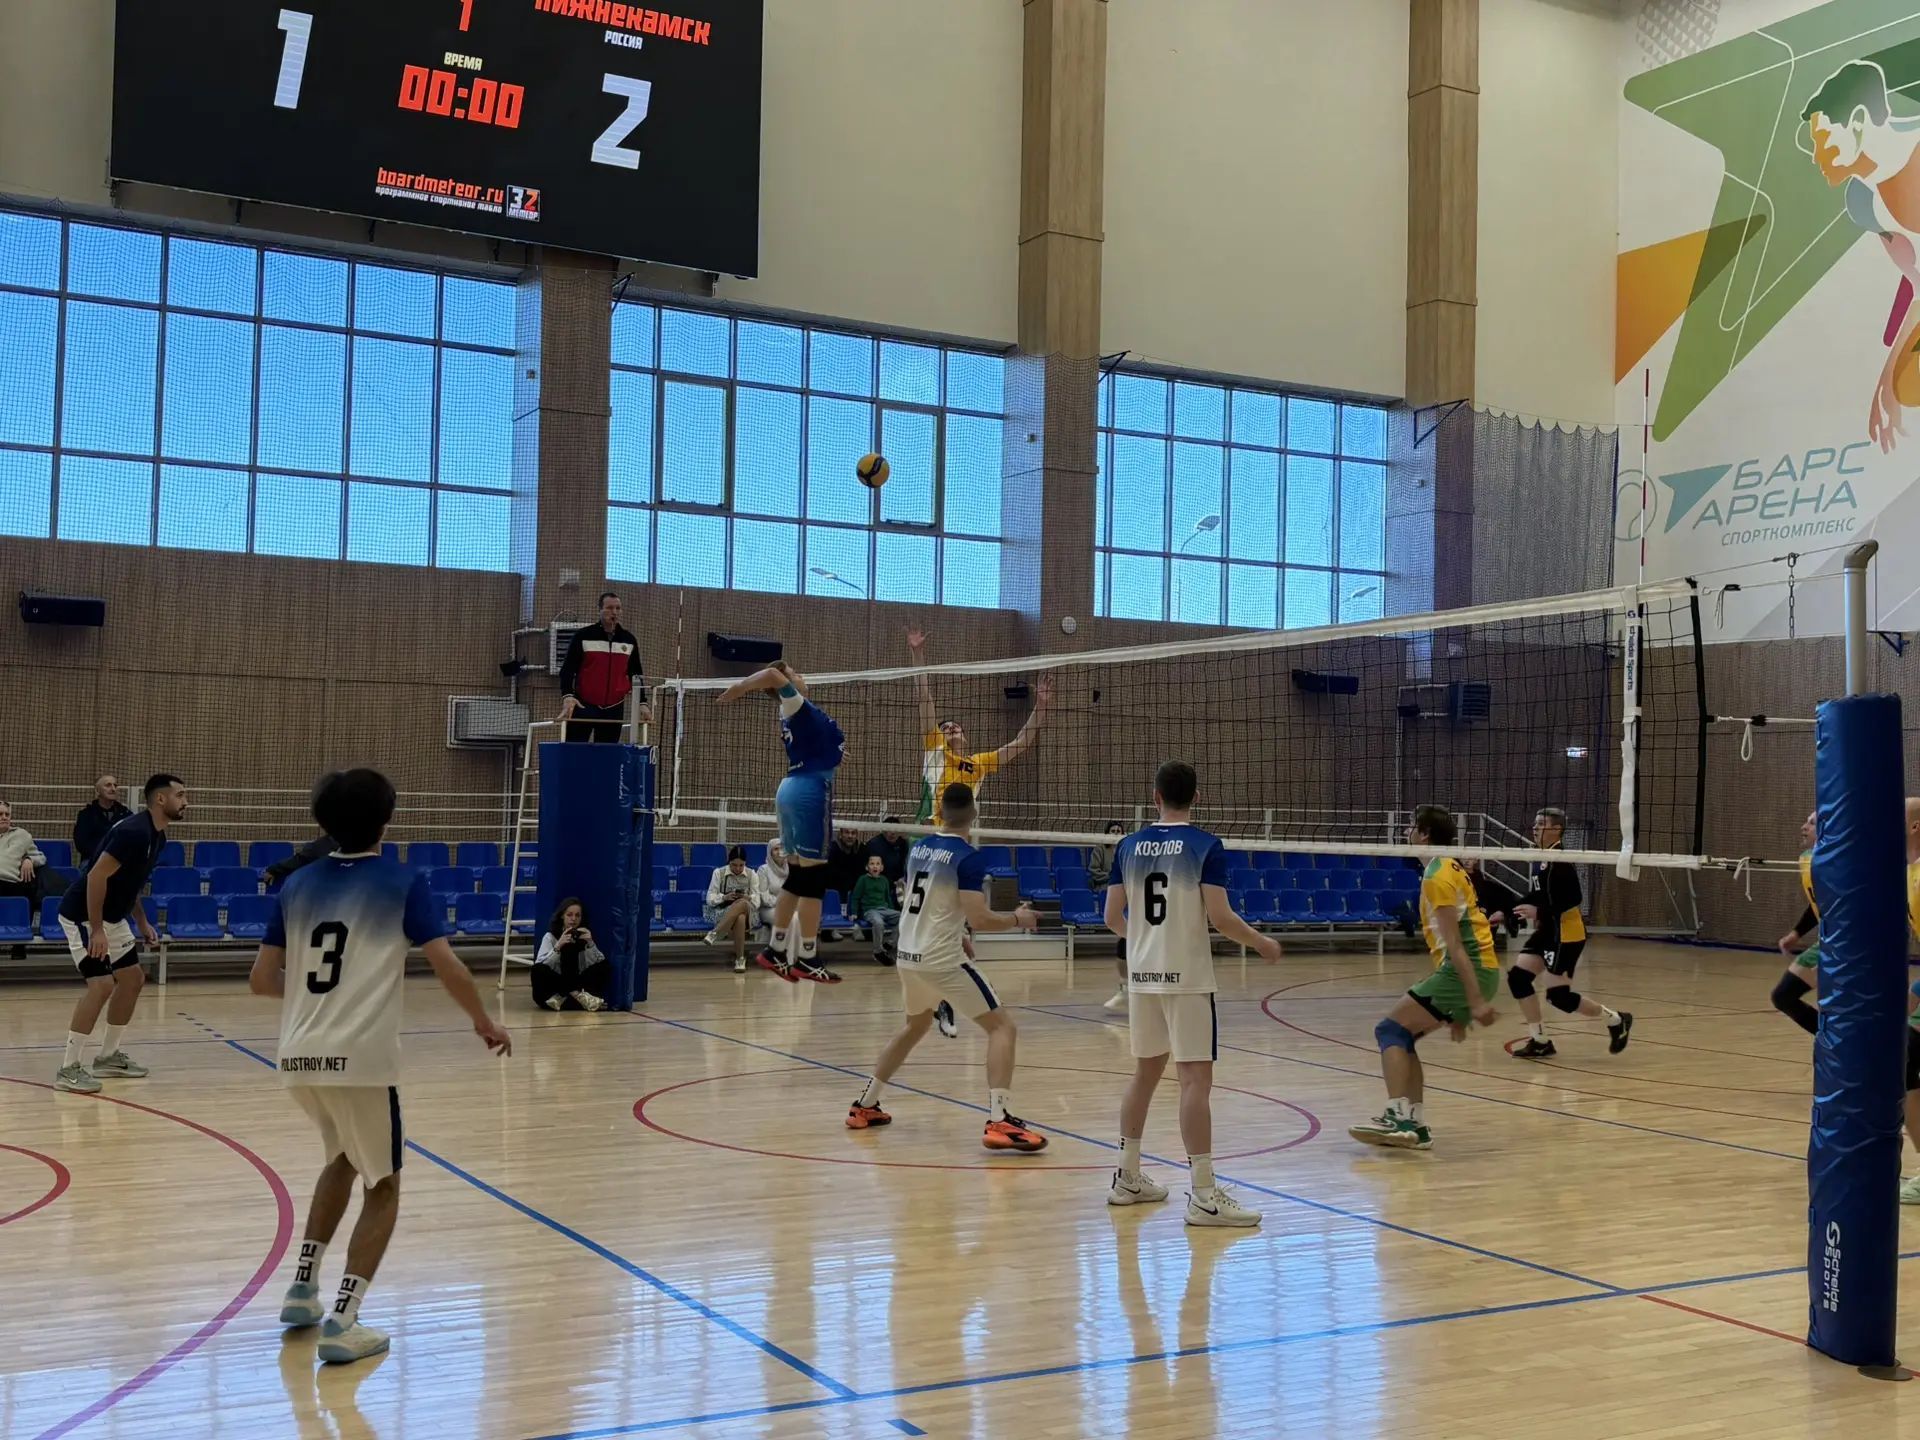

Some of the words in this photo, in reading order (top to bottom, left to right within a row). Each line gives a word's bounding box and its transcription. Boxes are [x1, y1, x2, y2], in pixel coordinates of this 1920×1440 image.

[274, 8, 314, 110] 1
[444, 51, 483, 71] ВРЕМЯ
[604, 30, 644, 50] РОССИЯ
[398, 64, 525, 129] 00:00
[590, 73, 652, 170] 2
[375, 186, 428, 203] программное
[430, 194, 476, 209] спортивное
[477, 203, 503, 214] табло
[376, 167, 504, 204] boardmeteor.ru
[510, 187, 538, 212] 32
[1732, 441, 1872, 491] БАРС
[1692, 480, 1858, 530] АРЕНА
[1721, 516, 1856, 547] СПОРТКОМПЛЕКС
[1134, 840, 1184, 857] КОЗЛОВ
[909, 871, 930, 915] 5
[1144, 872, 1168, 926] 6
[307, 921, 349, 994] 3
[1132, 971, 1181, 984] POLISTROY.NET
[1823, 1246, 1832, 1309] Sports
[1830, 1248, 1841, 1312] Schelde
